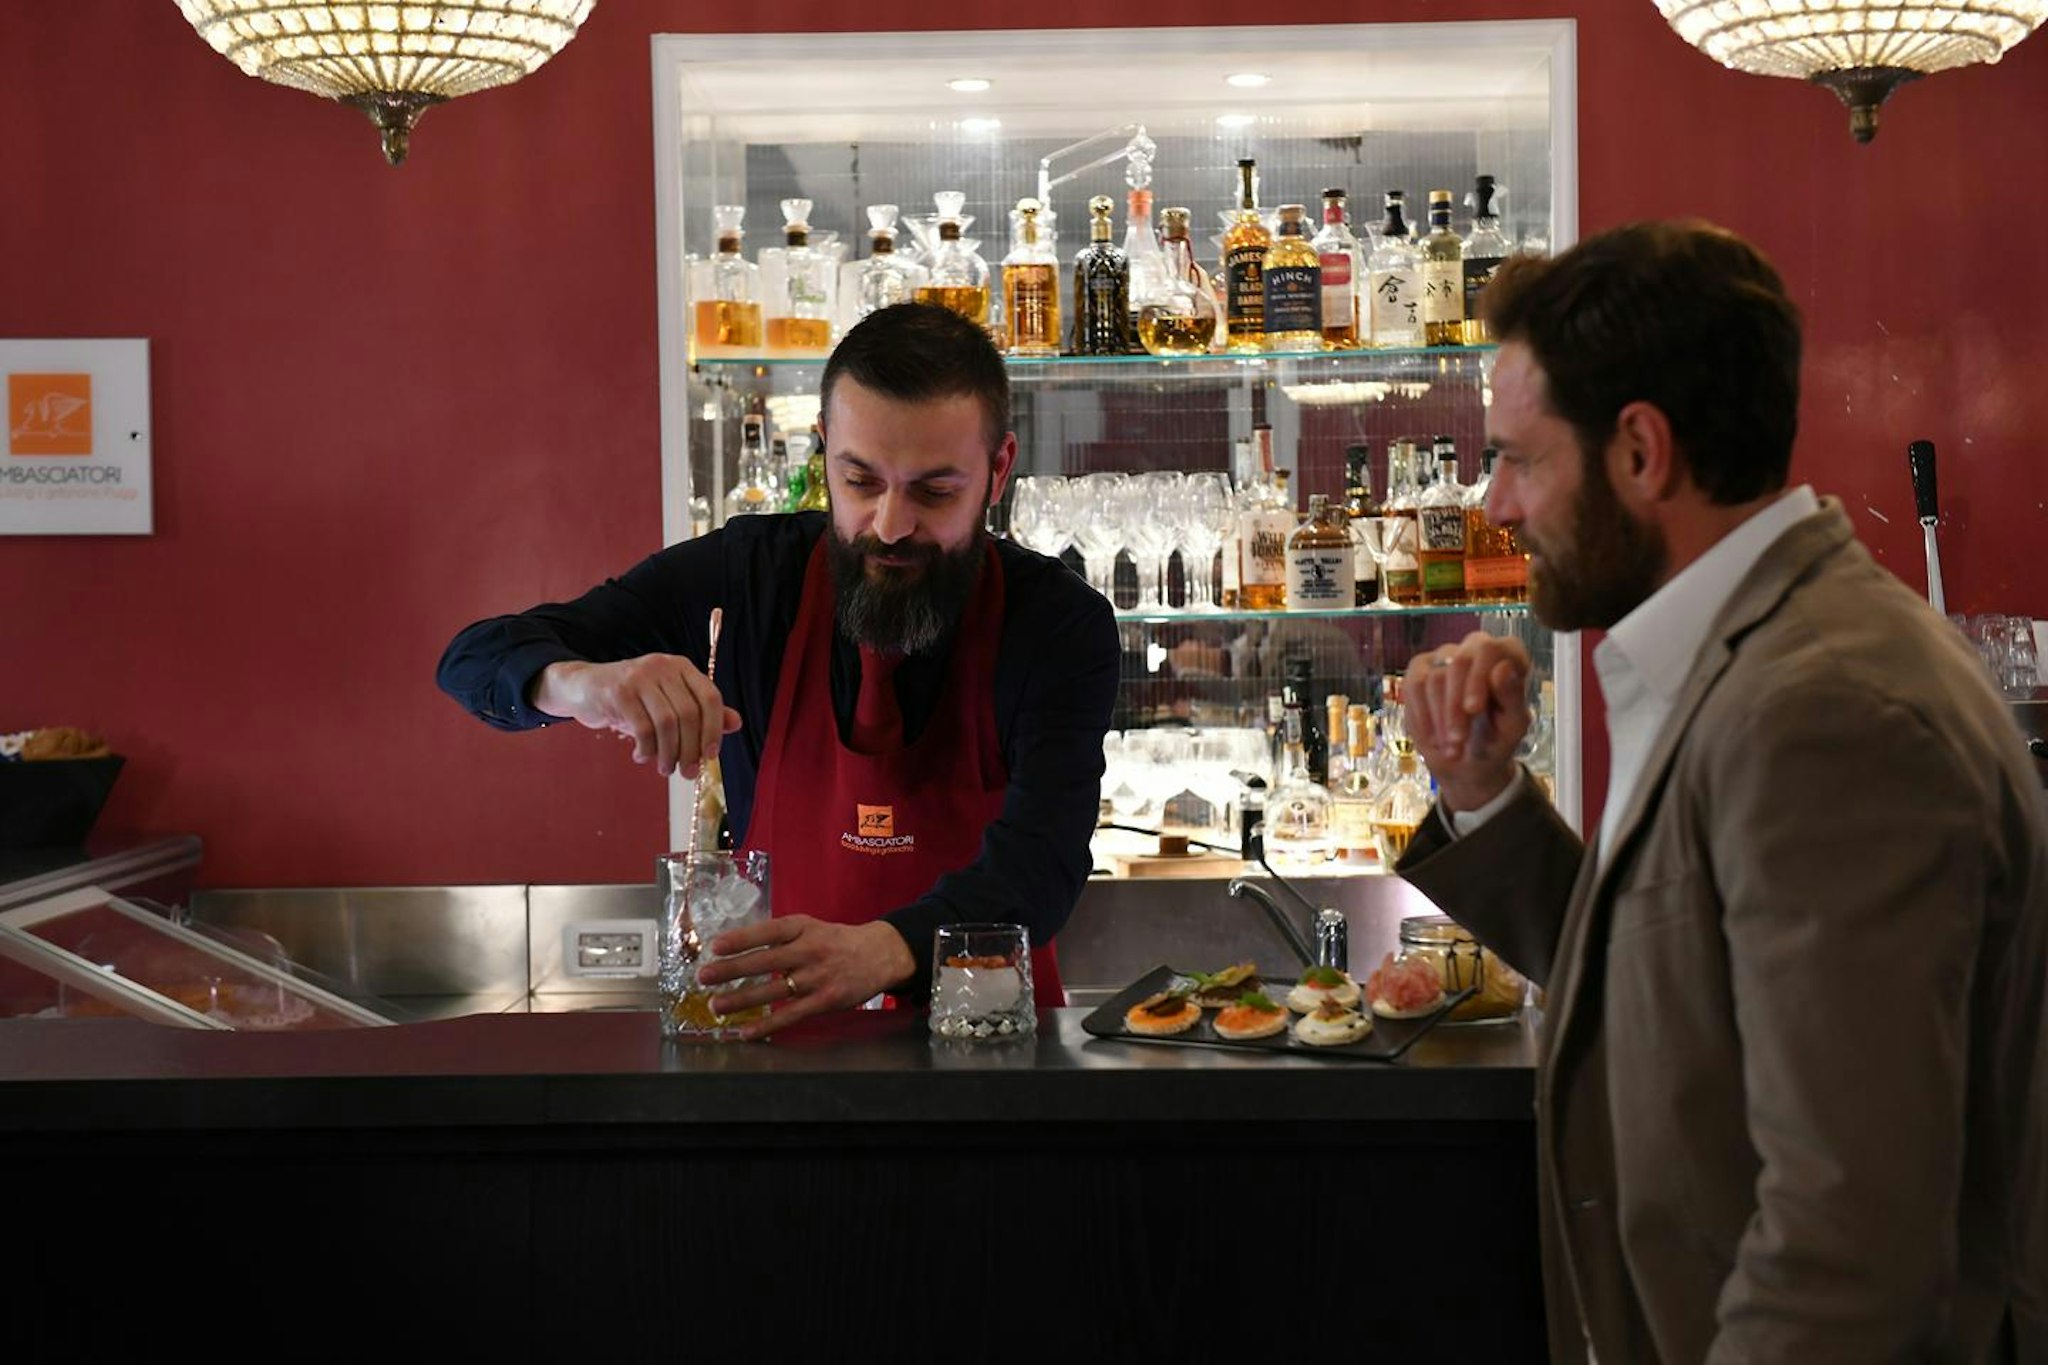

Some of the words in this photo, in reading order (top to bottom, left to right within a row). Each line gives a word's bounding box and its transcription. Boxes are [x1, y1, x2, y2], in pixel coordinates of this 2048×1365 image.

[1228, 251, 1262, 267] JAMES
[1271, 271, 1313, 285] HINCH
[0, 466, 122, 484] MBASCIATORI
[841, 832, 914, 847] AMBASCIATORI
